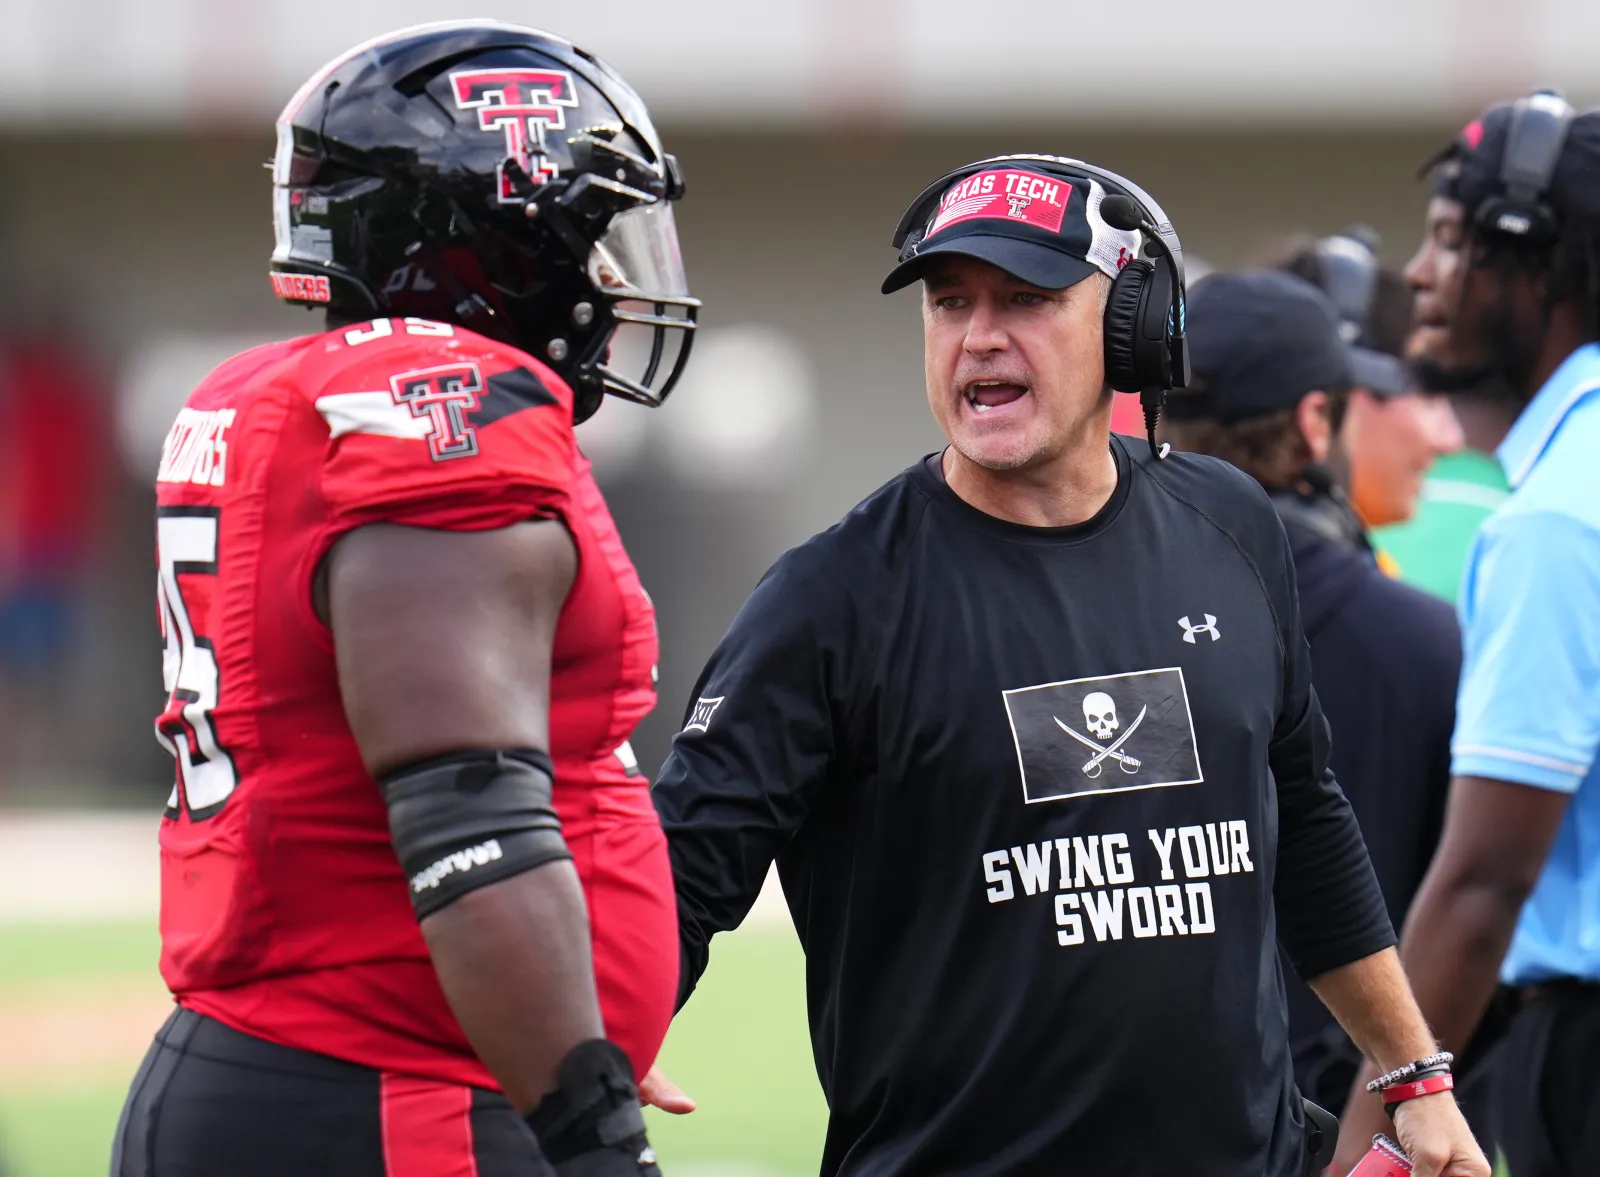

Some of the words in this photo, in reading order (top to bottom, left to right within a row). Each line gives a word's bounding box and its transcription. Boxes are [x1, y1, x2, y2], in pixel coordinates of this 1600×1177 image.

[943, 174, 996, 210] TEXAS
[1005, 173, 1059, 204] TECH
[982, 832, 1135, 903] SWING
[1148, 820, 1254, 880] YOUR
[1054, 882, 1216, 946] SWORD
